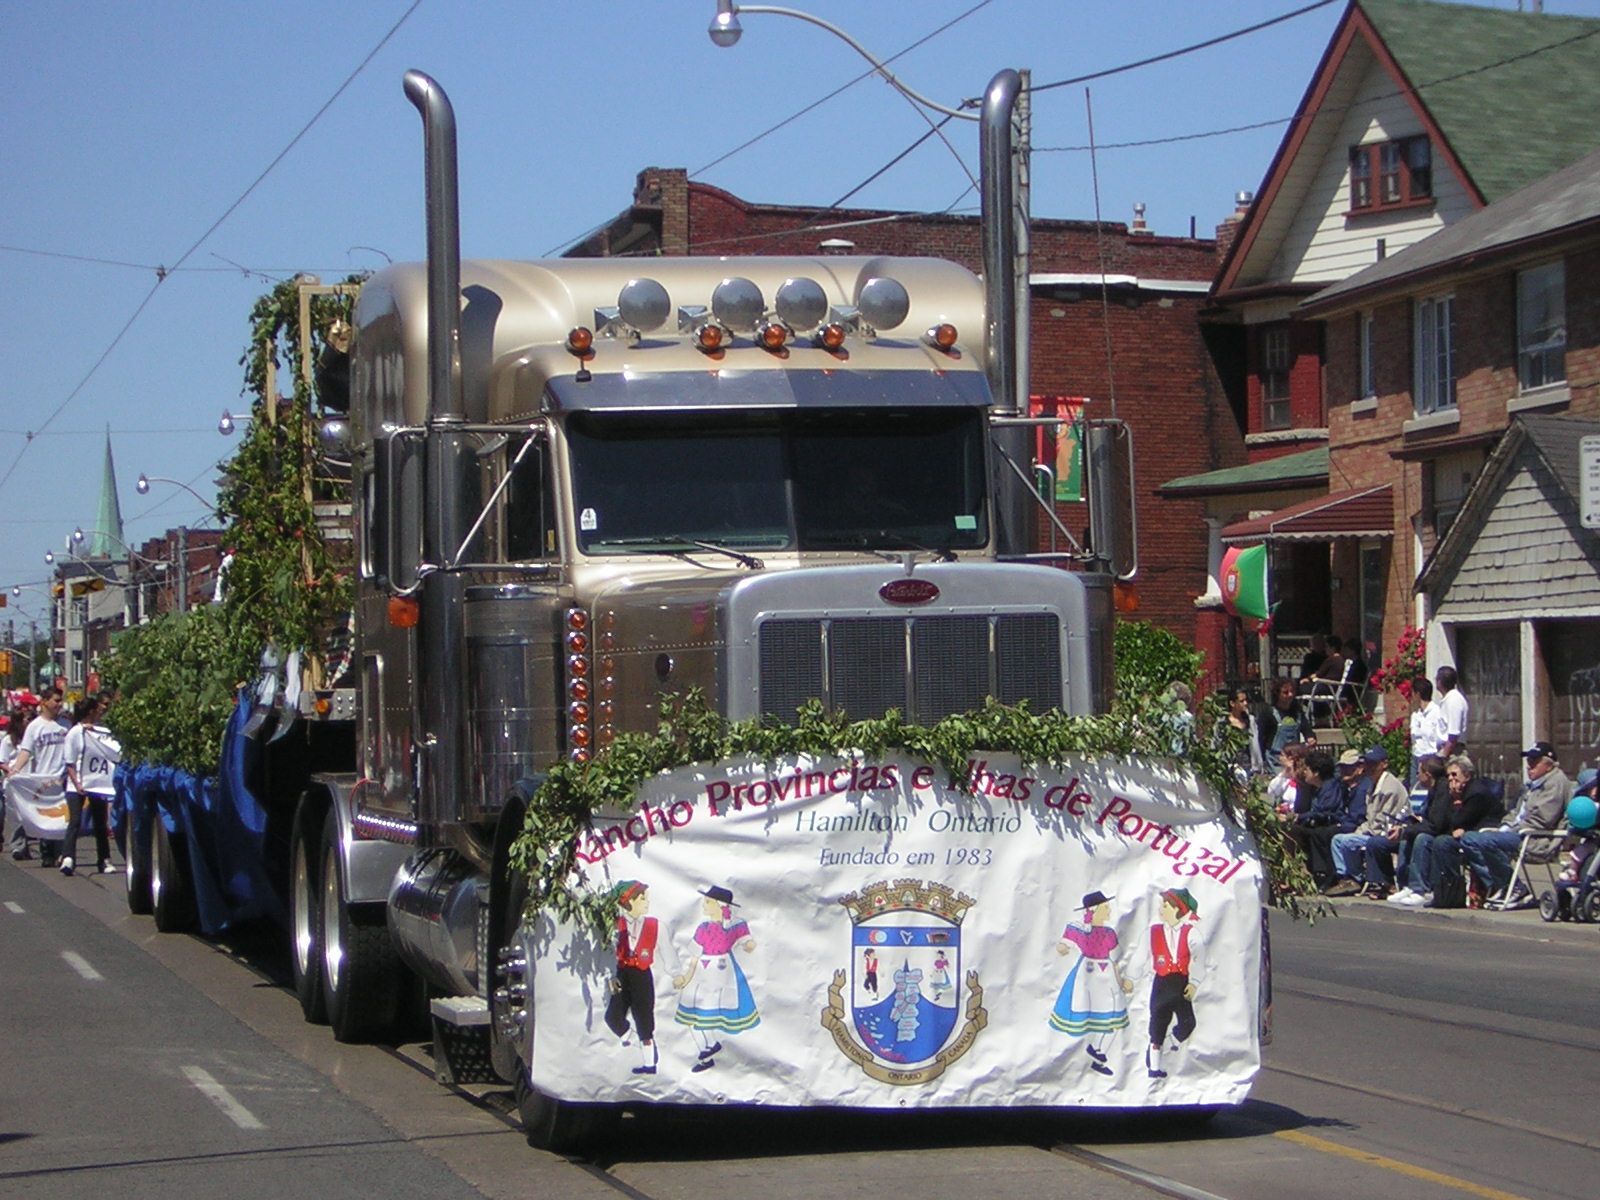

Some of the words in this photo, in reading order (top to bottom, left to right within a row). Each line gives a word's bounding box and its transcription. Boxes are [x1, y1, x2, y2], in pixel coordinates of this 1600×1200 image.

[705, 759, 899, 817] Provincias
[911, 765, 935, 790] e
[946, 759, 1036, 801] lhas
[1043, 777, 1092, 816] de
[1095, 795, 1246, 885] Portugal
[795, 808, 908, 832] Hamilton
[928, 809, 1021, 833] Ontario
[819, 847, 899, 865] Fundado
[906, 851, 935, 865] em
[944, 847, 993, 866] 1983
[887, 1071, 922, 1081] ONTARIO
[948, 1030, 974, 1058] CANADA
